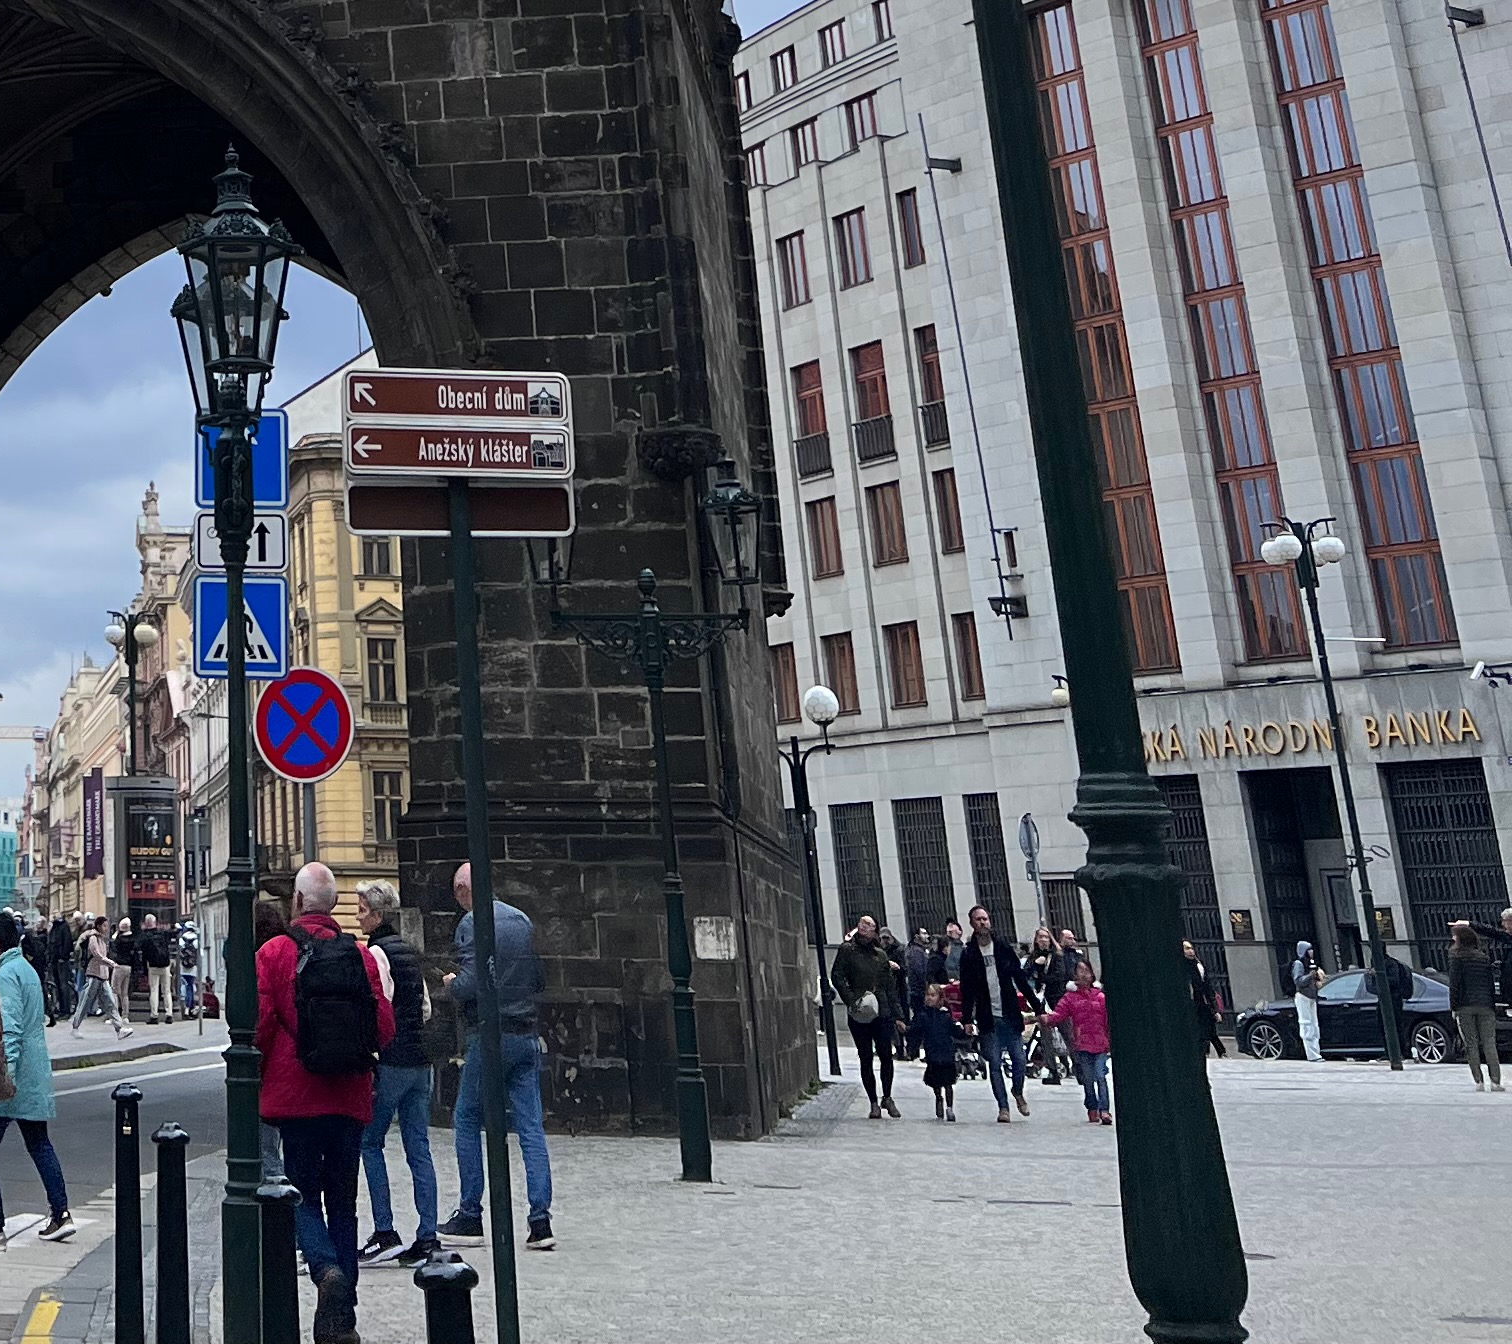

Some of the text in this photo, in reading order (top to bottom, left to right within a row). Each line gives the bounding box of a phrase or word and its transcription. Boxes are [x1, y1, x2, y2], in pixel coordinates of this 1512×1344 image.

[438, 385, 525, 410] Obecní dům
[419, 437, 528, 467] Anežský klášter
[1198, 719, 1334, 759] NÁRODN
[1363, 708, 1482, 748] BANKA
